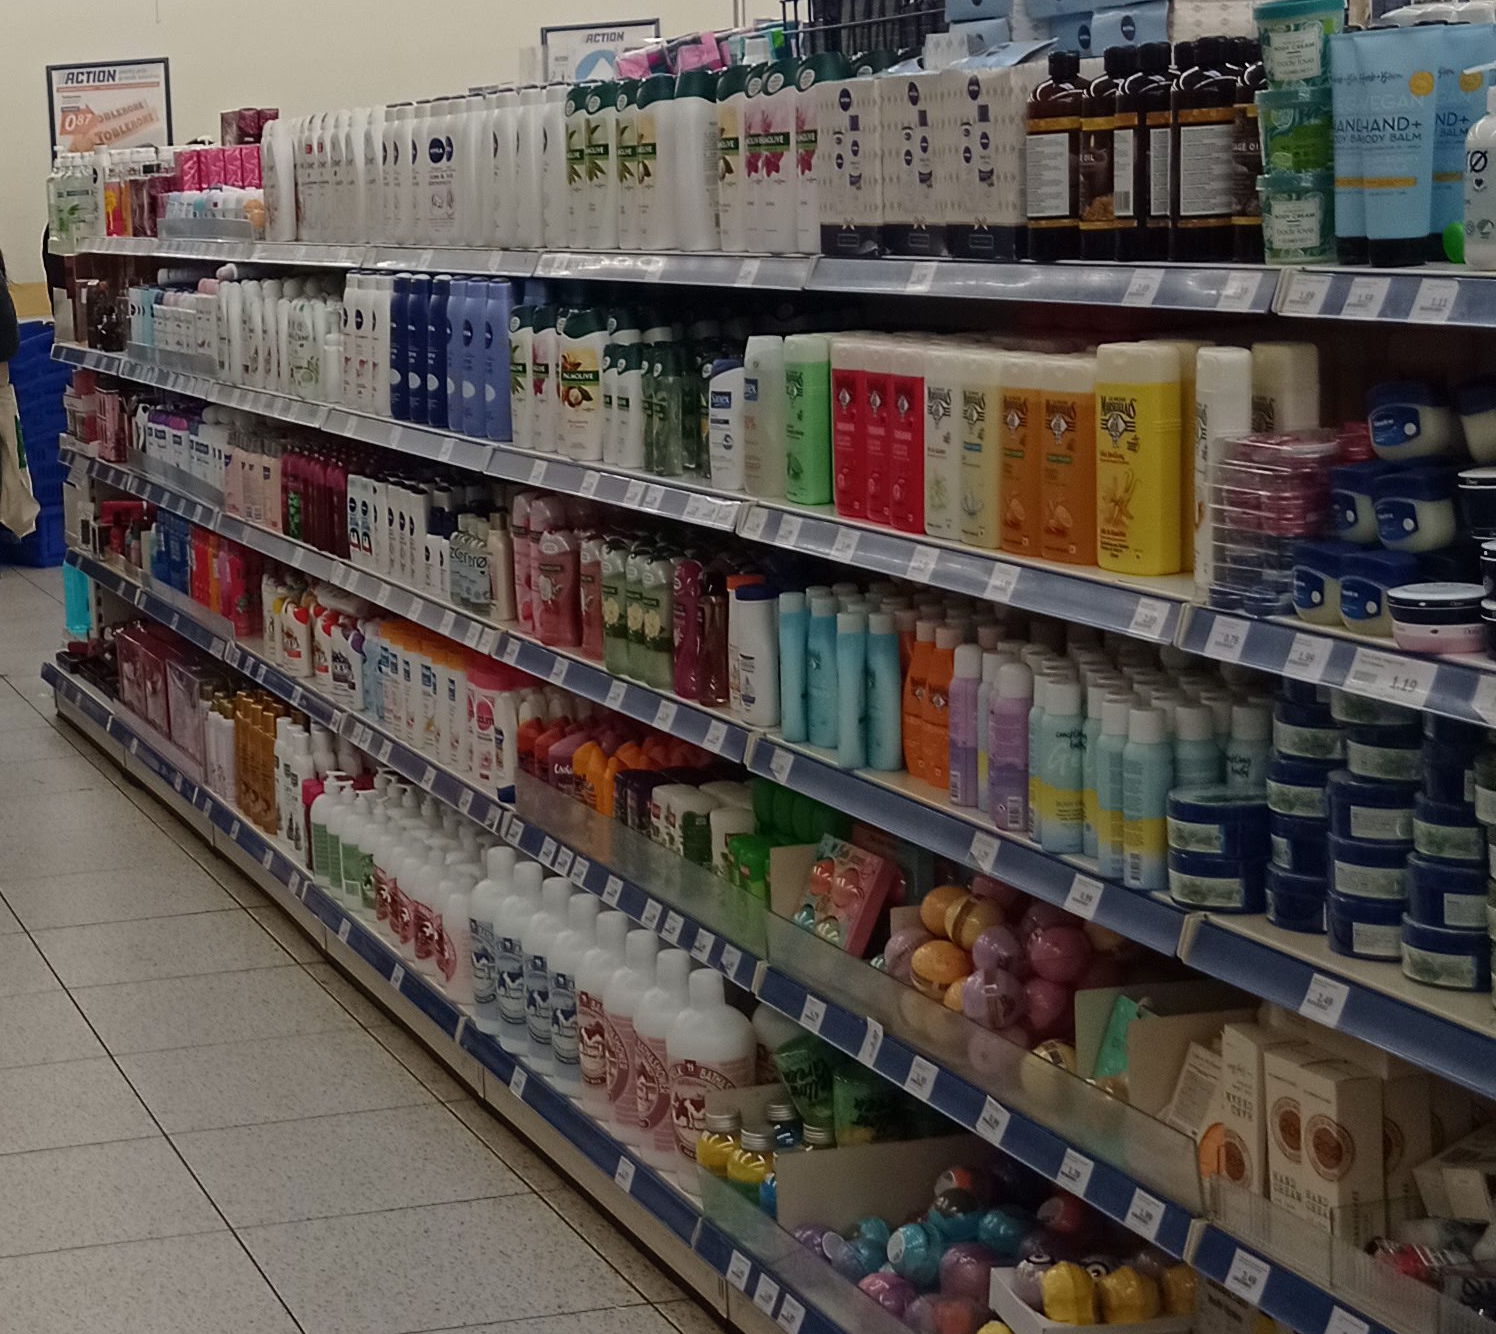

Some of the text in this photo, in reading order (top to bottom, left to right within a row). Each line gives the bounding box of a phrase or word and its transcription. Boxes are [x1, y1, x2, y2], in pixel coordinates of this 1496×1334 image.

[586, 31, 624, 43] ACTION
[64, 69, 117, 85] ACTION
[1390, 675, 1418, 693] 1.19
